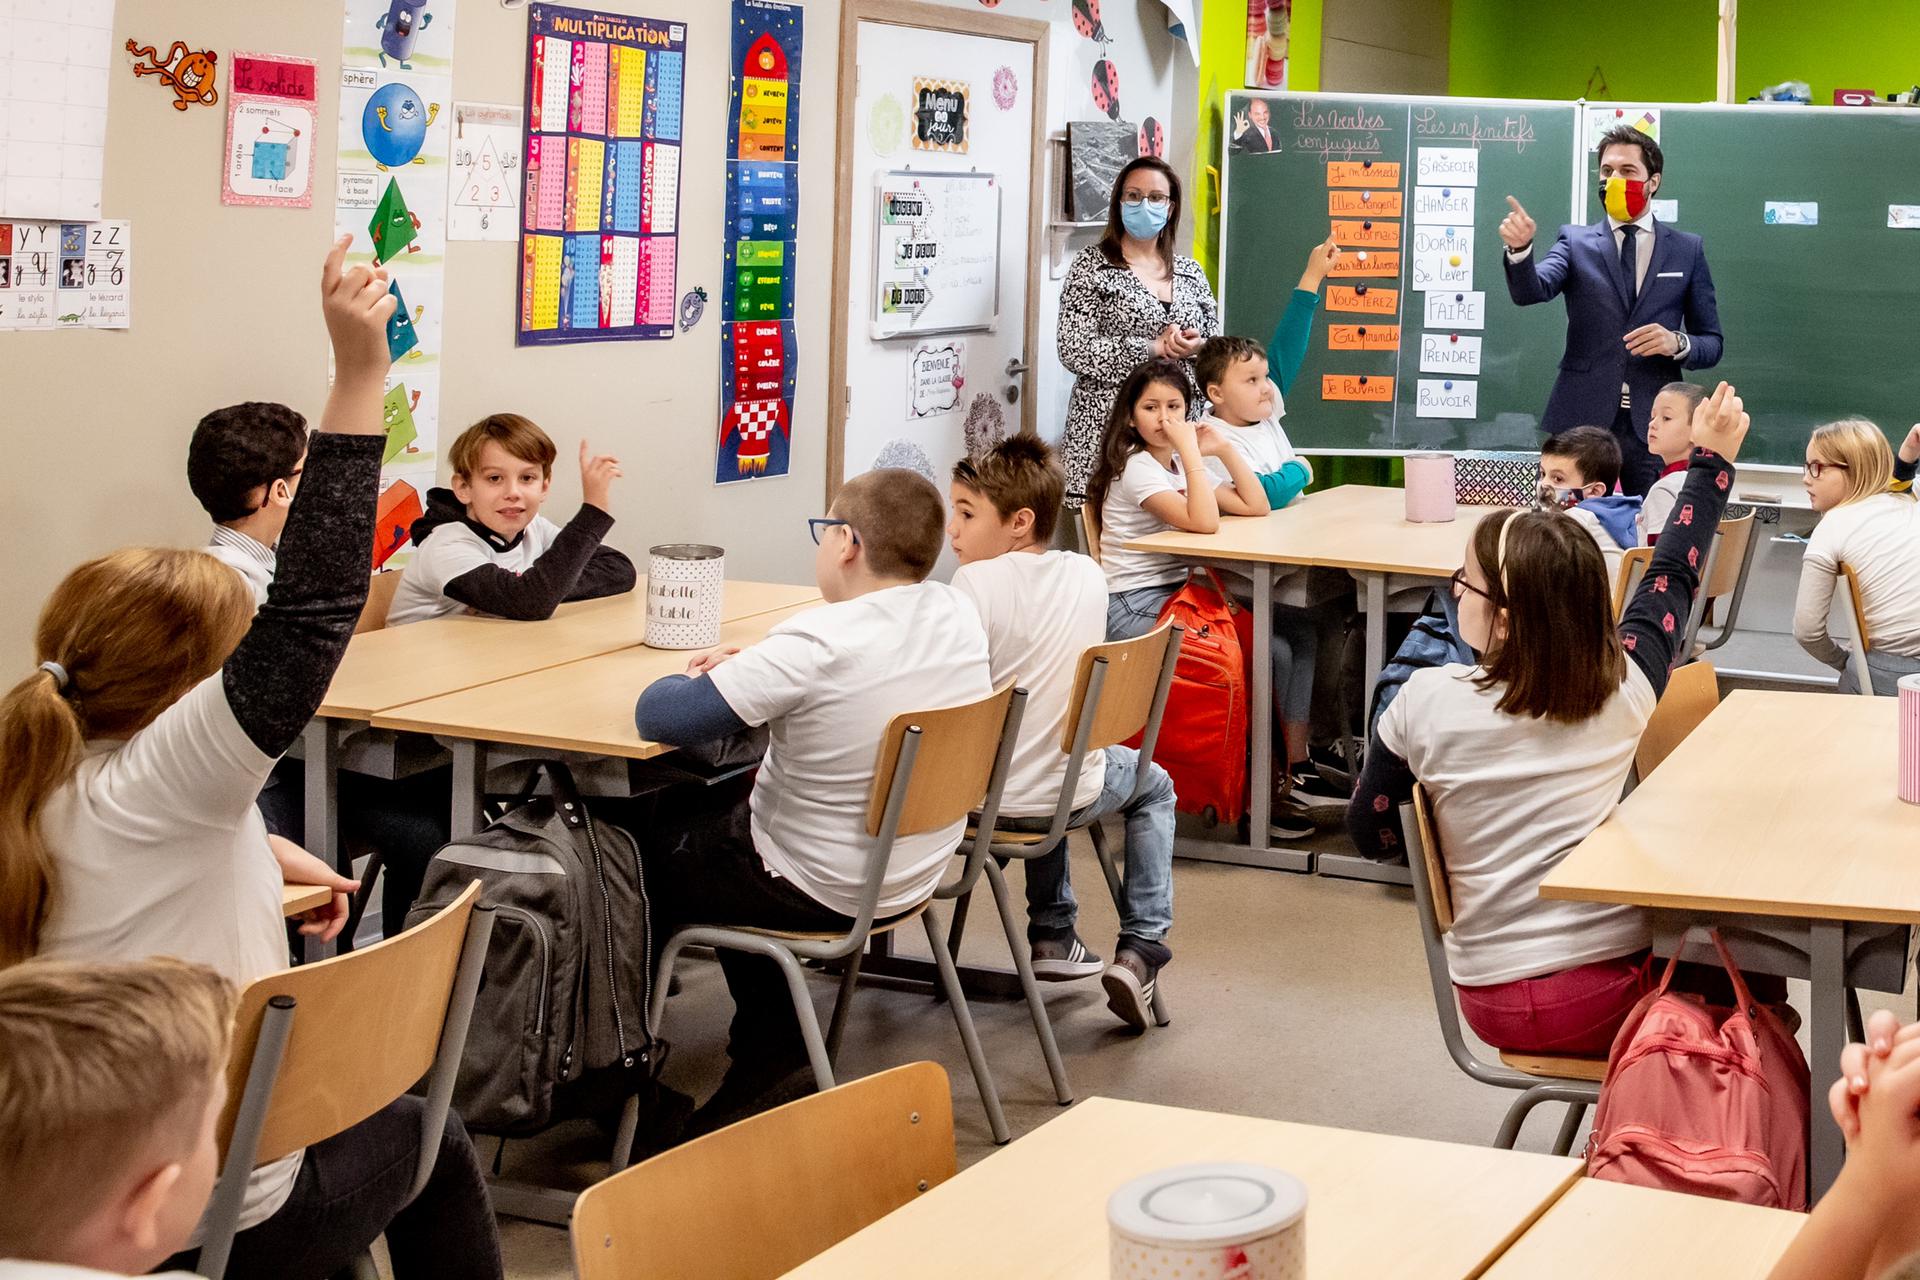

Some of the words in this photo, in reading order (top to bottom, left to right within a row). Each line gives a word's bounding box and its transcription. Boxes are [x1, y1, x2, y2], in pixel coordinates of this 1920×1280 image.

[554, 16, 669, 48] MULTIPLICATION
[536, 39, 543, 55] 1
[575, 44, 584, 59] 2
[234, 58, 254, 91] Le
[257, 66, 306, 97] solide
[343, 73, 374, 88] sphère
[925, 92, 958, 112] Menu
[246, 108, 280, 116] sommets
[1292, 99, 1325, 129] Les
[1328, 105, 1384, 130] verbes
[927, 119, 955, 135] jour
[1414, 106, 1446, 134] Les
[1449, 112, 1534, 153] infinitifs
[531, 138, 539, 155] 5
[571, 142, 577, 157] 6
[759, 144, 784, 152] CONTENT
[1290, 131, 1380, 164] conjugués
[456, 150, 472, 166] 10
[482, 154, 491, 171] 5
[1419, 156, 1476, 176] S'ASSEOIR
[275, 184, 294, 193] face
[343, 177, 373, 186] pyramide
[353, 186, 369, 195] base
[471, 184, 480, 201] 2
[491, 185, 500, 201] 3
[338, 197, 377, 207] triangulaire
[1332, 195, 1355, 211] Elles
[1357, 196, 1398, 215] changent
[480, 213, 490, 230] 6
[19, 227, 30, 250] y
[38, 225, 47, 243] Y
[92, 230, 102, 245] z
[109, 226, 120, 245] Z
[1333, 225, 1346, 239] Tu
[526, 238, 535, 255] 9
[565, 238, 576, 254] 10
[602, 239, 613, 255] 11
[640, 239, 651, 255] 12
[1415, 232, 1468, 254] DORMIR
[1415, 259, 1433, 284] Se
[18, 294, 26, 303] le
[27, 294, 45, 305] stylo
[89, 293, 97, 302] le
[98, 293, 124, 302] lézard
[1429, 294, 1476, 321] FAIRE
[1333, 327, 1355, 344] Tu
[1424, 337, 1477, 365] PRENDRE
[1323, 378, 1338, 396] Je
[1419, 387, 1473, 408] POUVOIR
[660, 605, 694, 620] table
